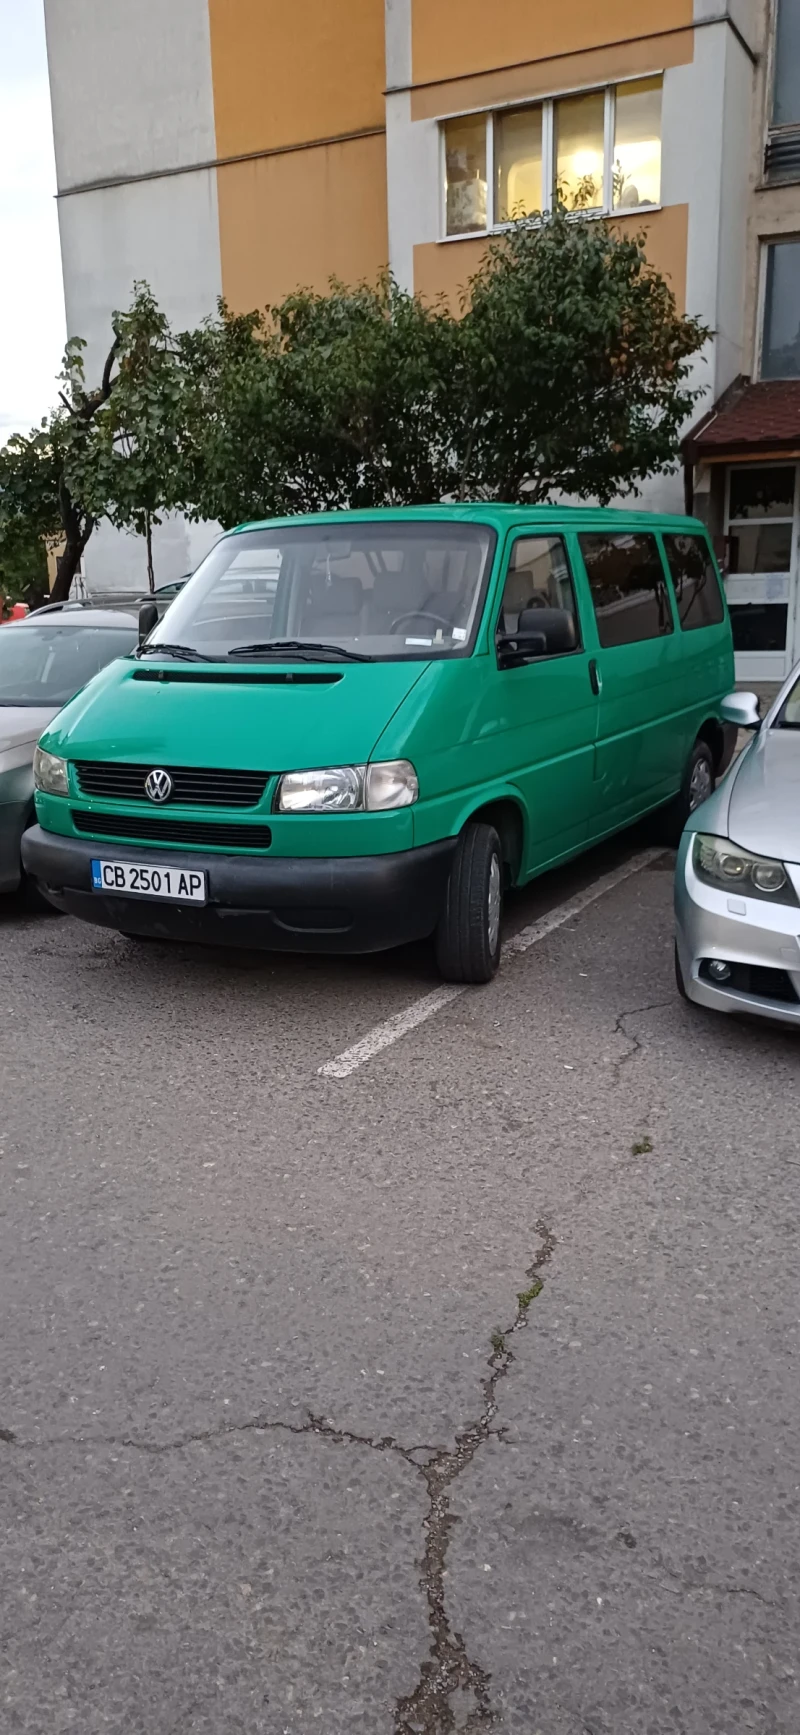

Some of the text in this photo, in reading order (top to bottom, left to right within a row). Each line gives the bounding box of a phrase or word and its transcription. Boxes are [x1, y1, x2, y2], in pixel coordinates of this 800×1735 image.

[145, 770, 171, 801] VW
[103, 865, 201, 896] CB 2501 AP
